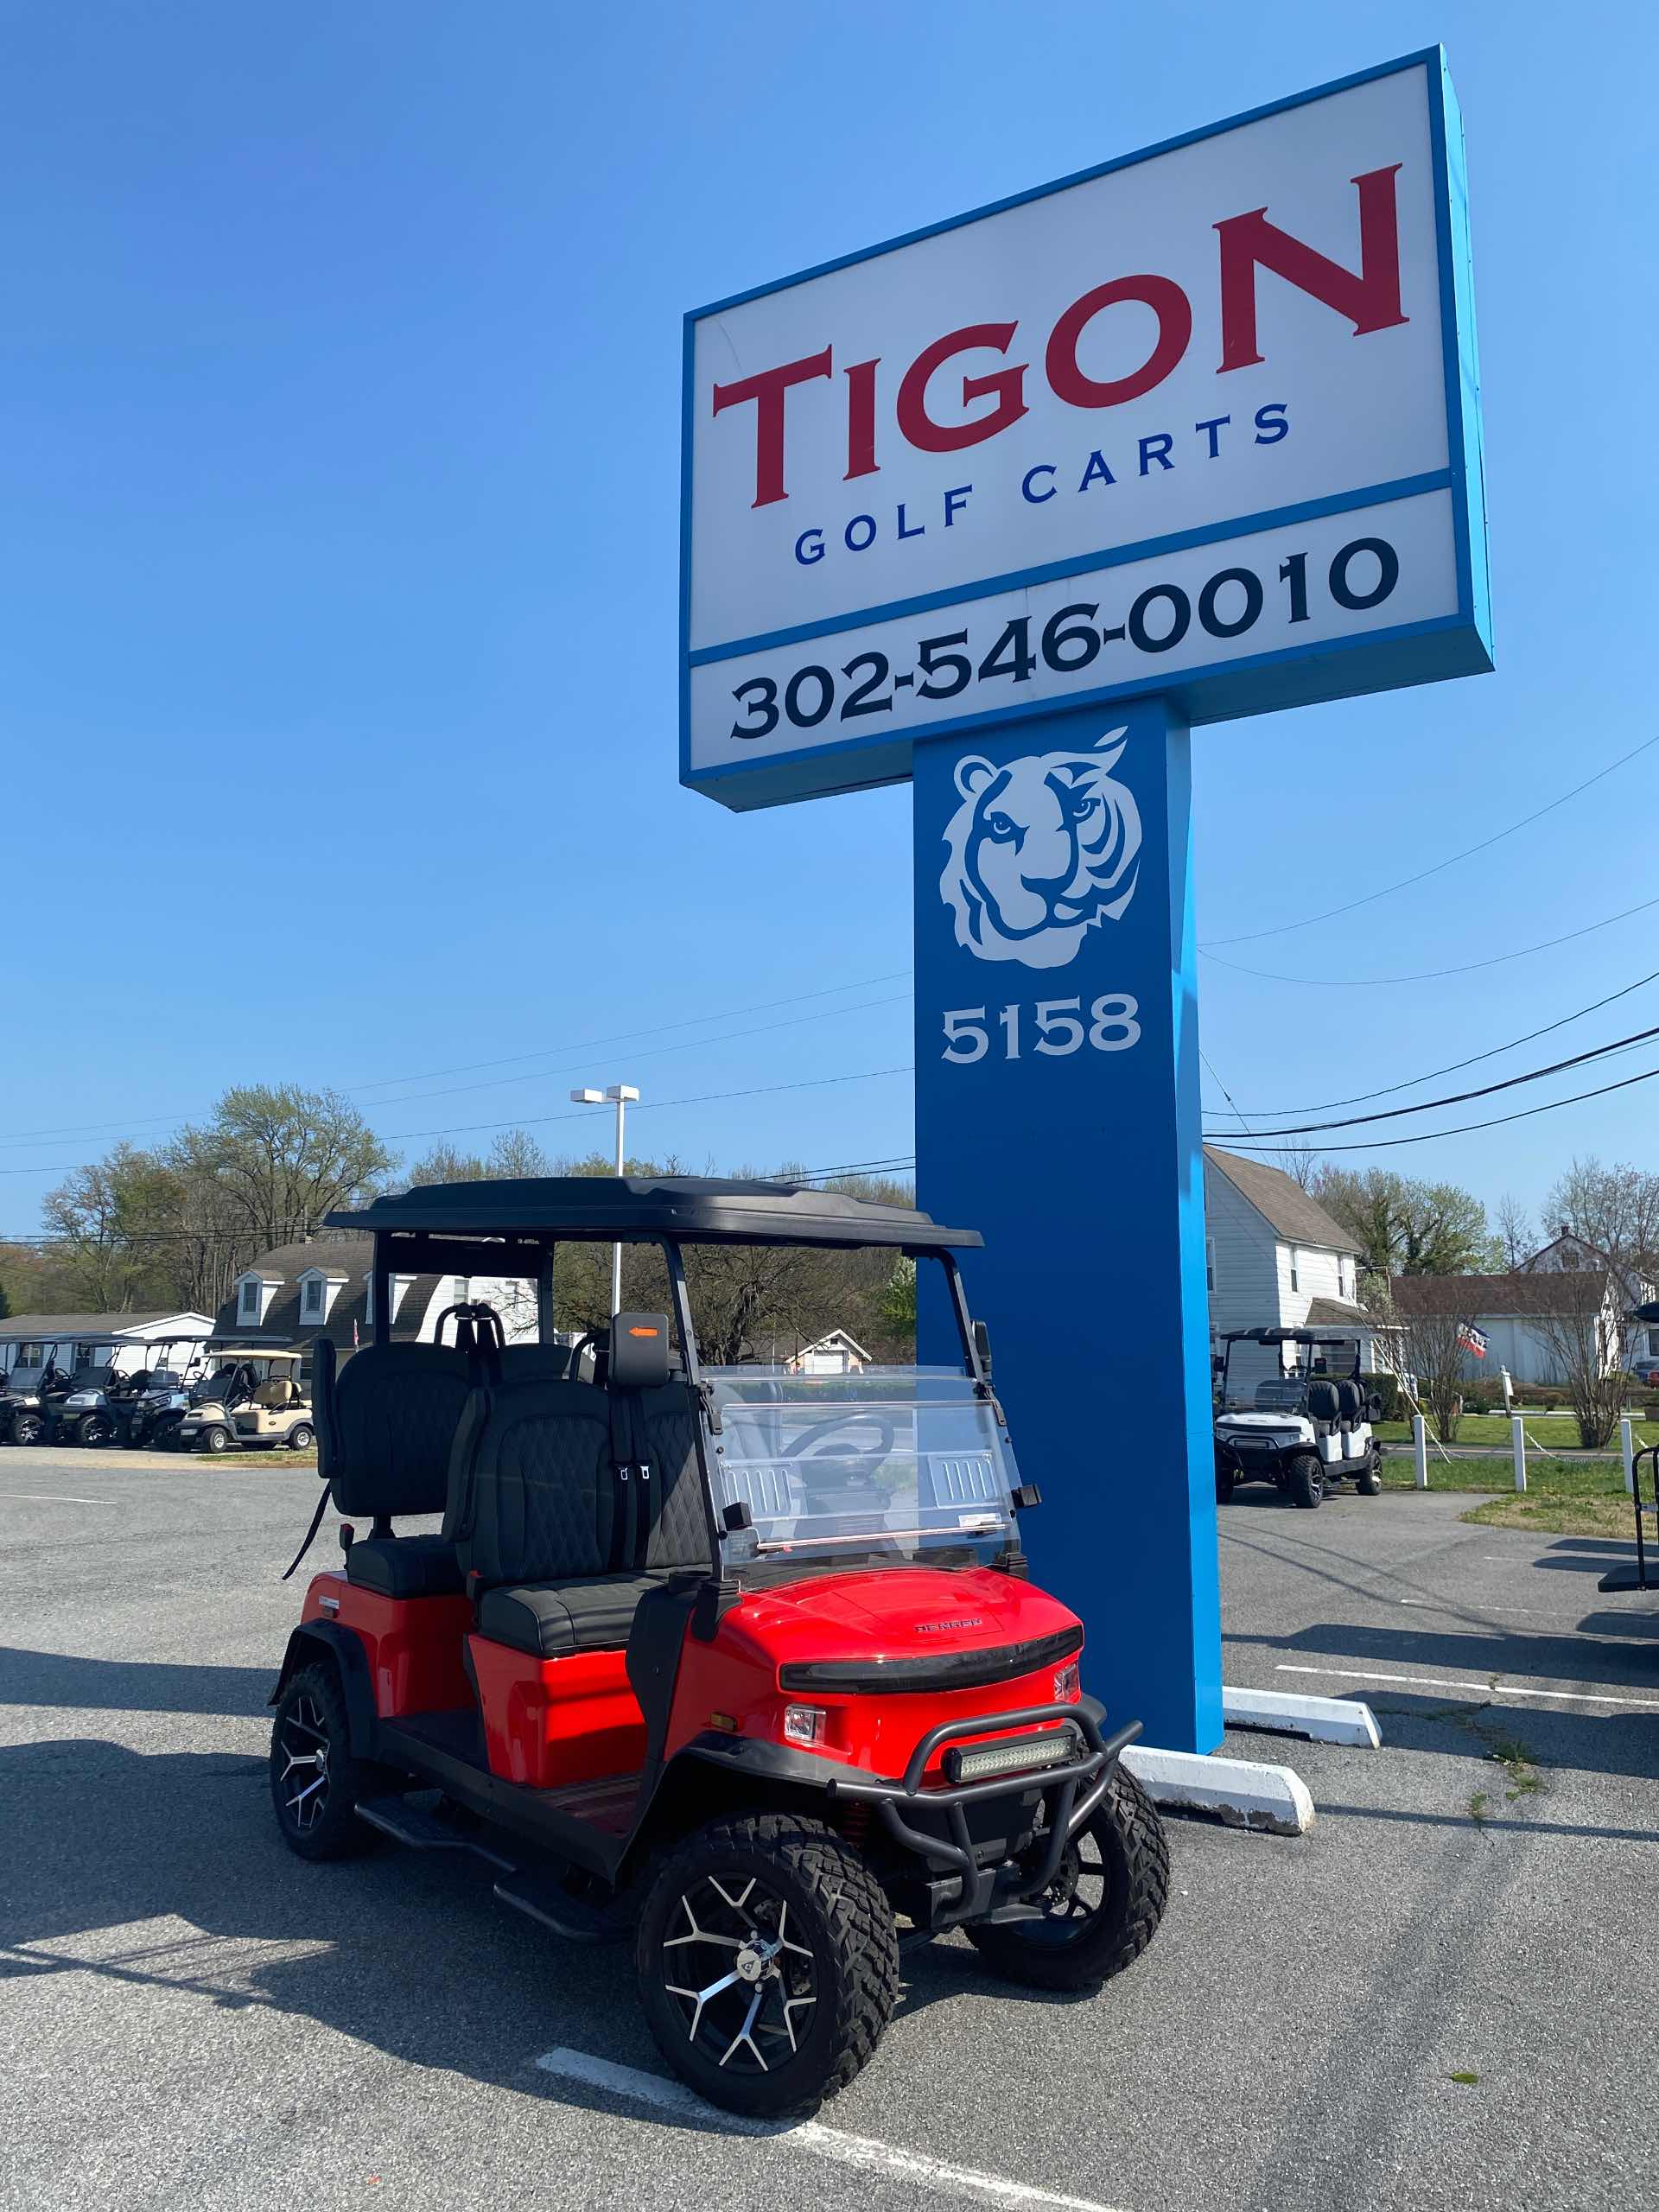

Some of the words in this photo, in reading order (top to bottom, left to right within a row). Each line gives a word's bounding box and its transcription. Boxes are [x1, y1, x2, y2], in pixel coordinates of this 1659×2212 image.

[713, 162, 1410, 509] TIGON
[794, 486, 973, 566] GOLF
[1021, 403, 1290, 504] CARTS
[730, 537, 1400, 740] 302-546-0010
[941, 993, 1141, 1064] 5158
